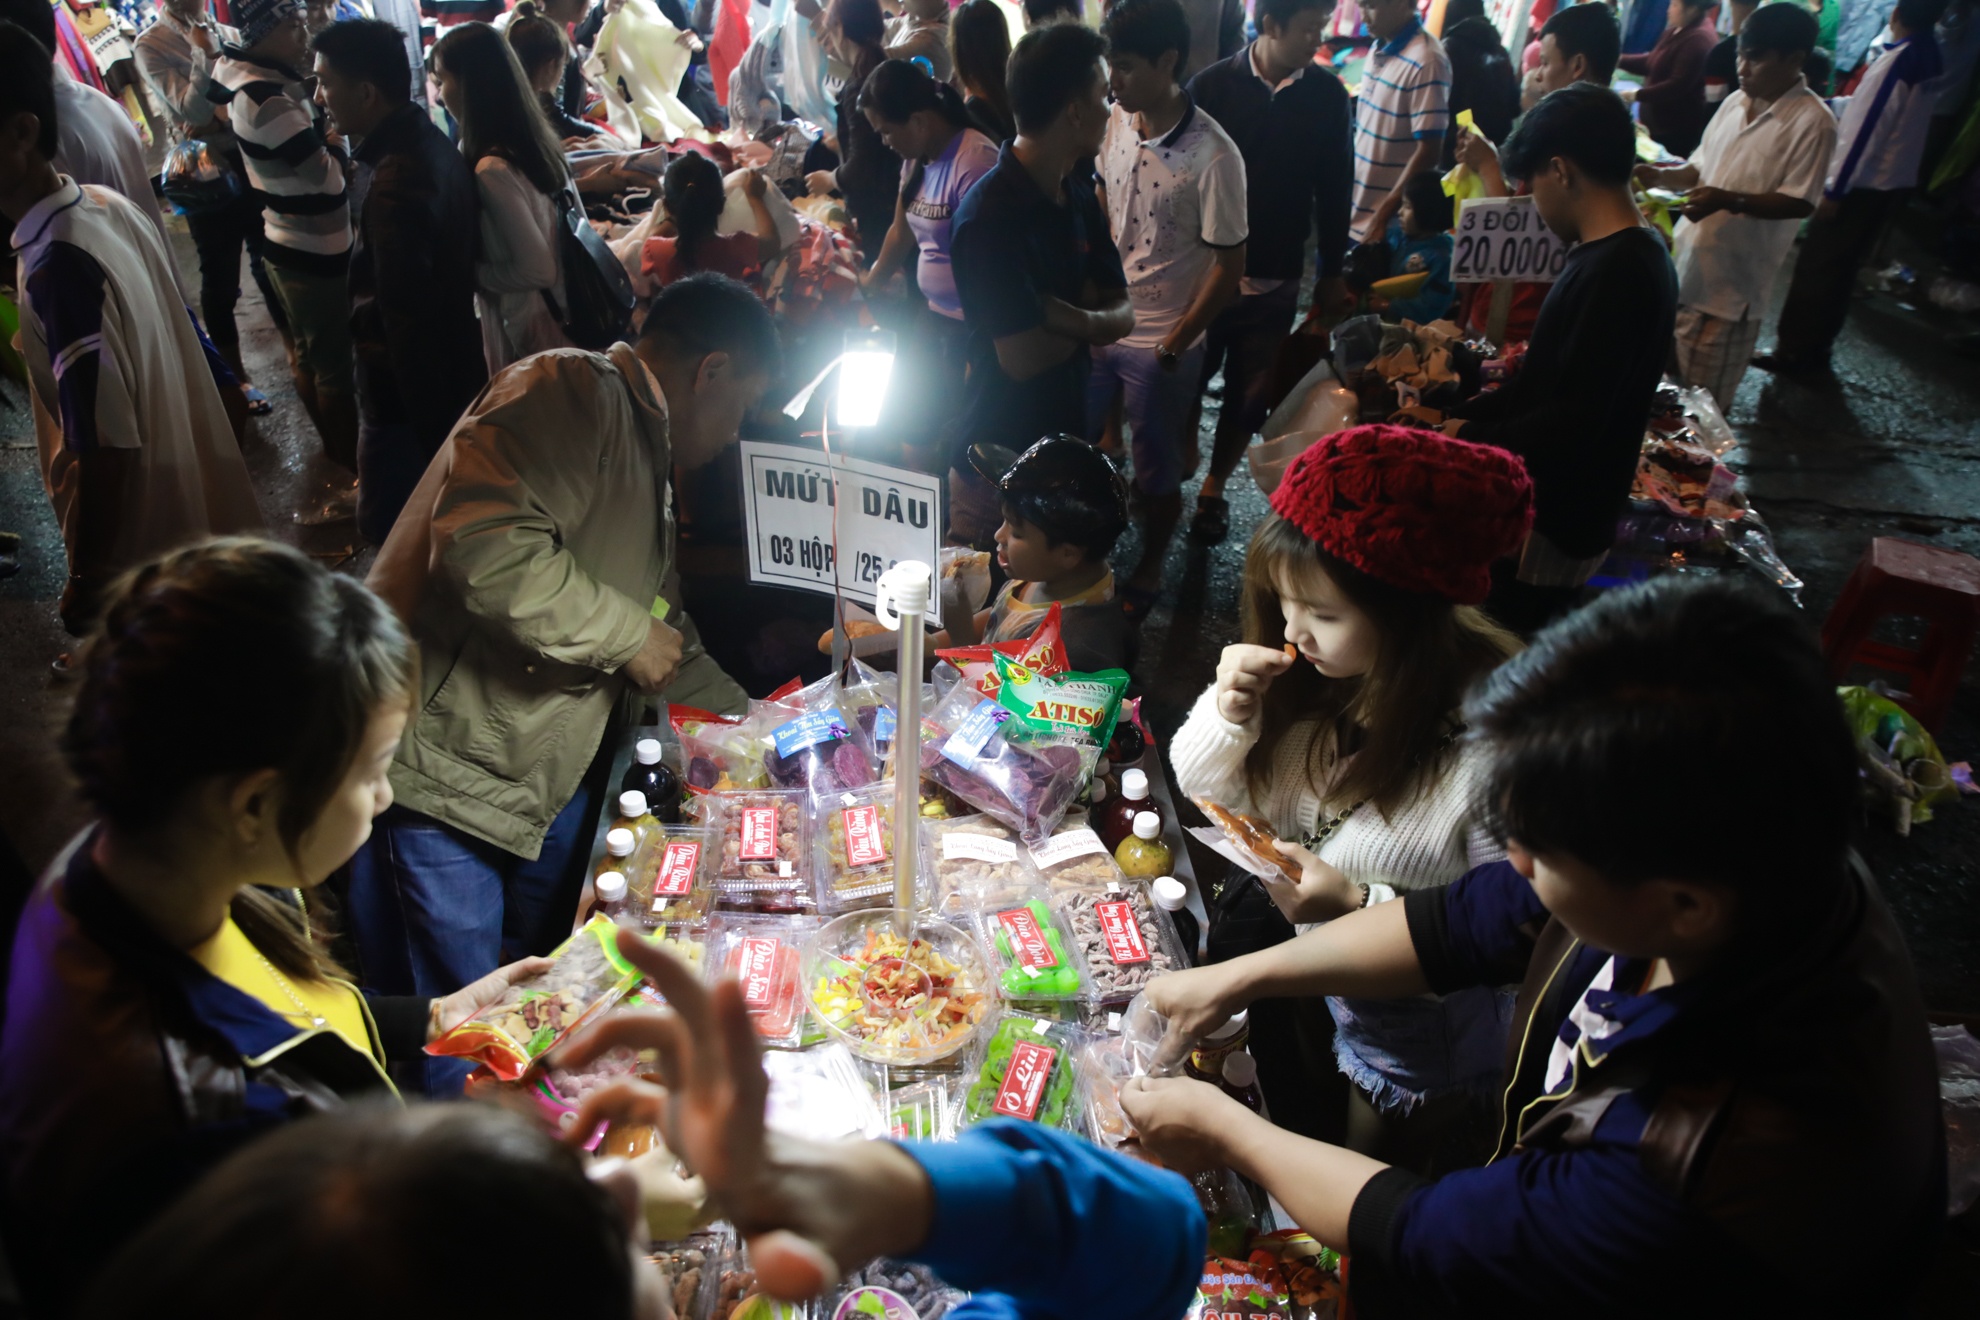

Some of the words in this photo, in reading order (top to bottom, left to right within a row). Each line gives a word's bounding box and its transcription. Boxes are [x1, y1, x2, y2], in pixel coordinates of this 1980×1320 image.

[1462, 211, 1477, 231] 3
[765, 468, 840, 507] MỨT
[862, 487, 929, 529] DÂU
[770, 534, 794, 566] 03
[799, 535, 836, 578] HỘP
[981, 645, 1055, 691] ASÔ
[1003, 1092, 1022, 1111] Ô
[1015, 1049, 1039, 1091] Liu
